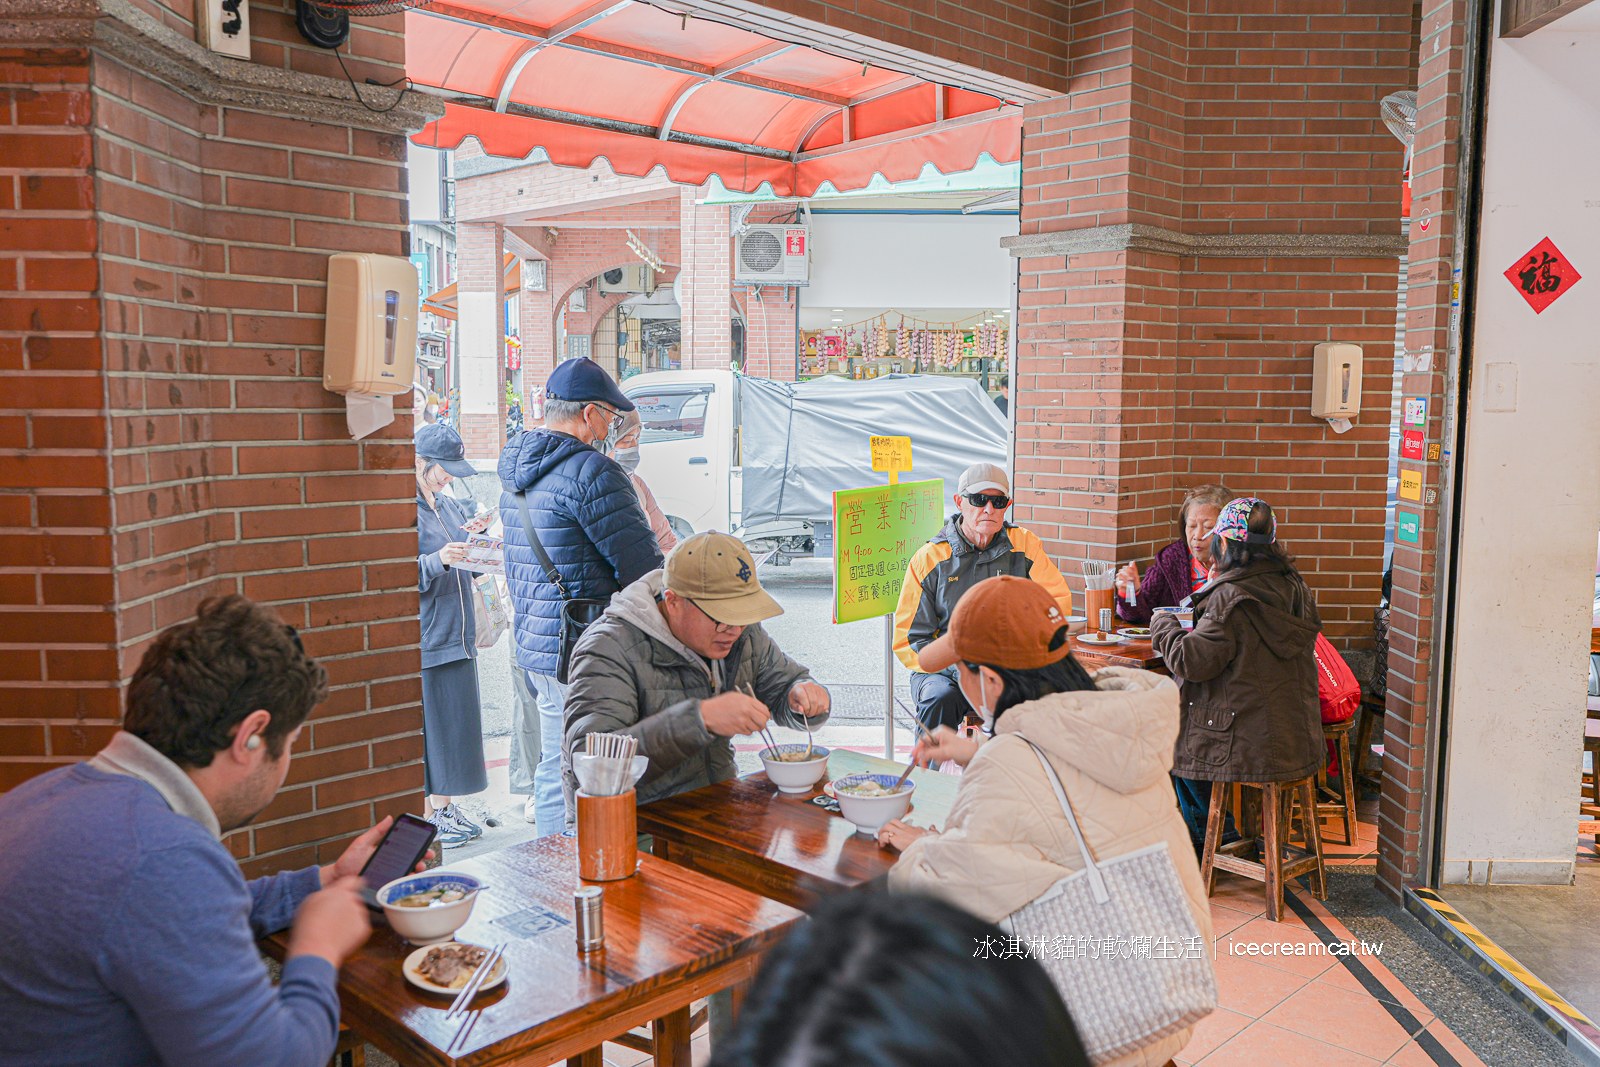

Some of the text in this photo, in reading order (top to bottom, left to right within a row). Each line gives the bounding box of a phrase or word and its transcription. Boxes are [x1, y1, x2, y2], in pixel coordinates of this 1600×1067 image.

[1518, 251, 1561, 295] 福
[846, 488, 939, 535] 營業時間
[854, 544, 873, 562] 9:00
[849, 557, 911, 581] 固定每週(三)店
[1317, 658, 1338, 687] ARMOUR
